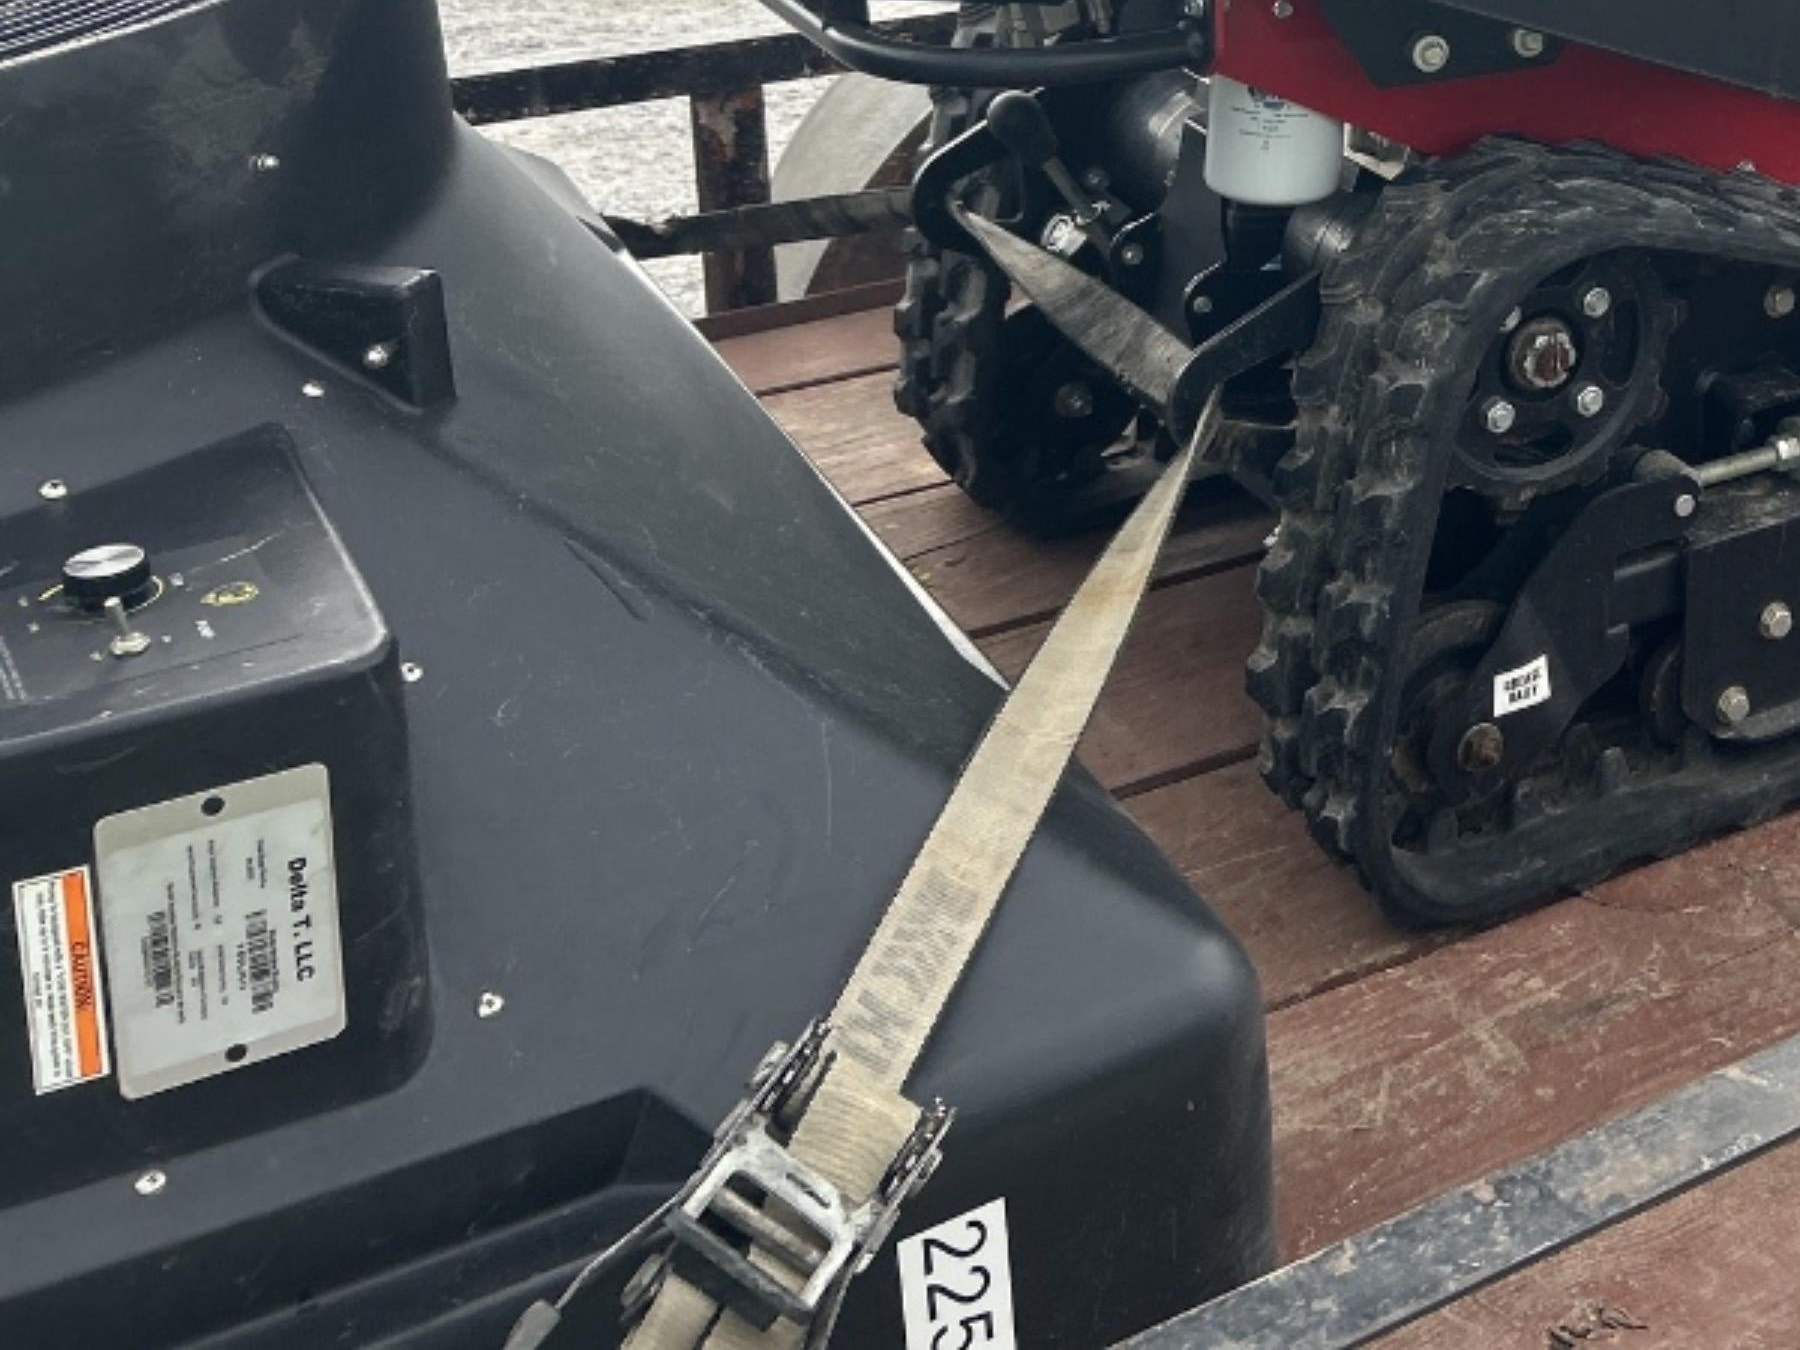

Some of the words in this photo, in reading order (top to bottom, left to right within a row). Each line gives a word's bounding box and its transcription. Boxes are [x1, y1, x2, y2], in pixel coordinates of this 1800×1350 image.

[287, 856, 310, 913] Delta
[71, 941, 95, 1011] CAUTION
[293, 940, 316, 983] LLC
